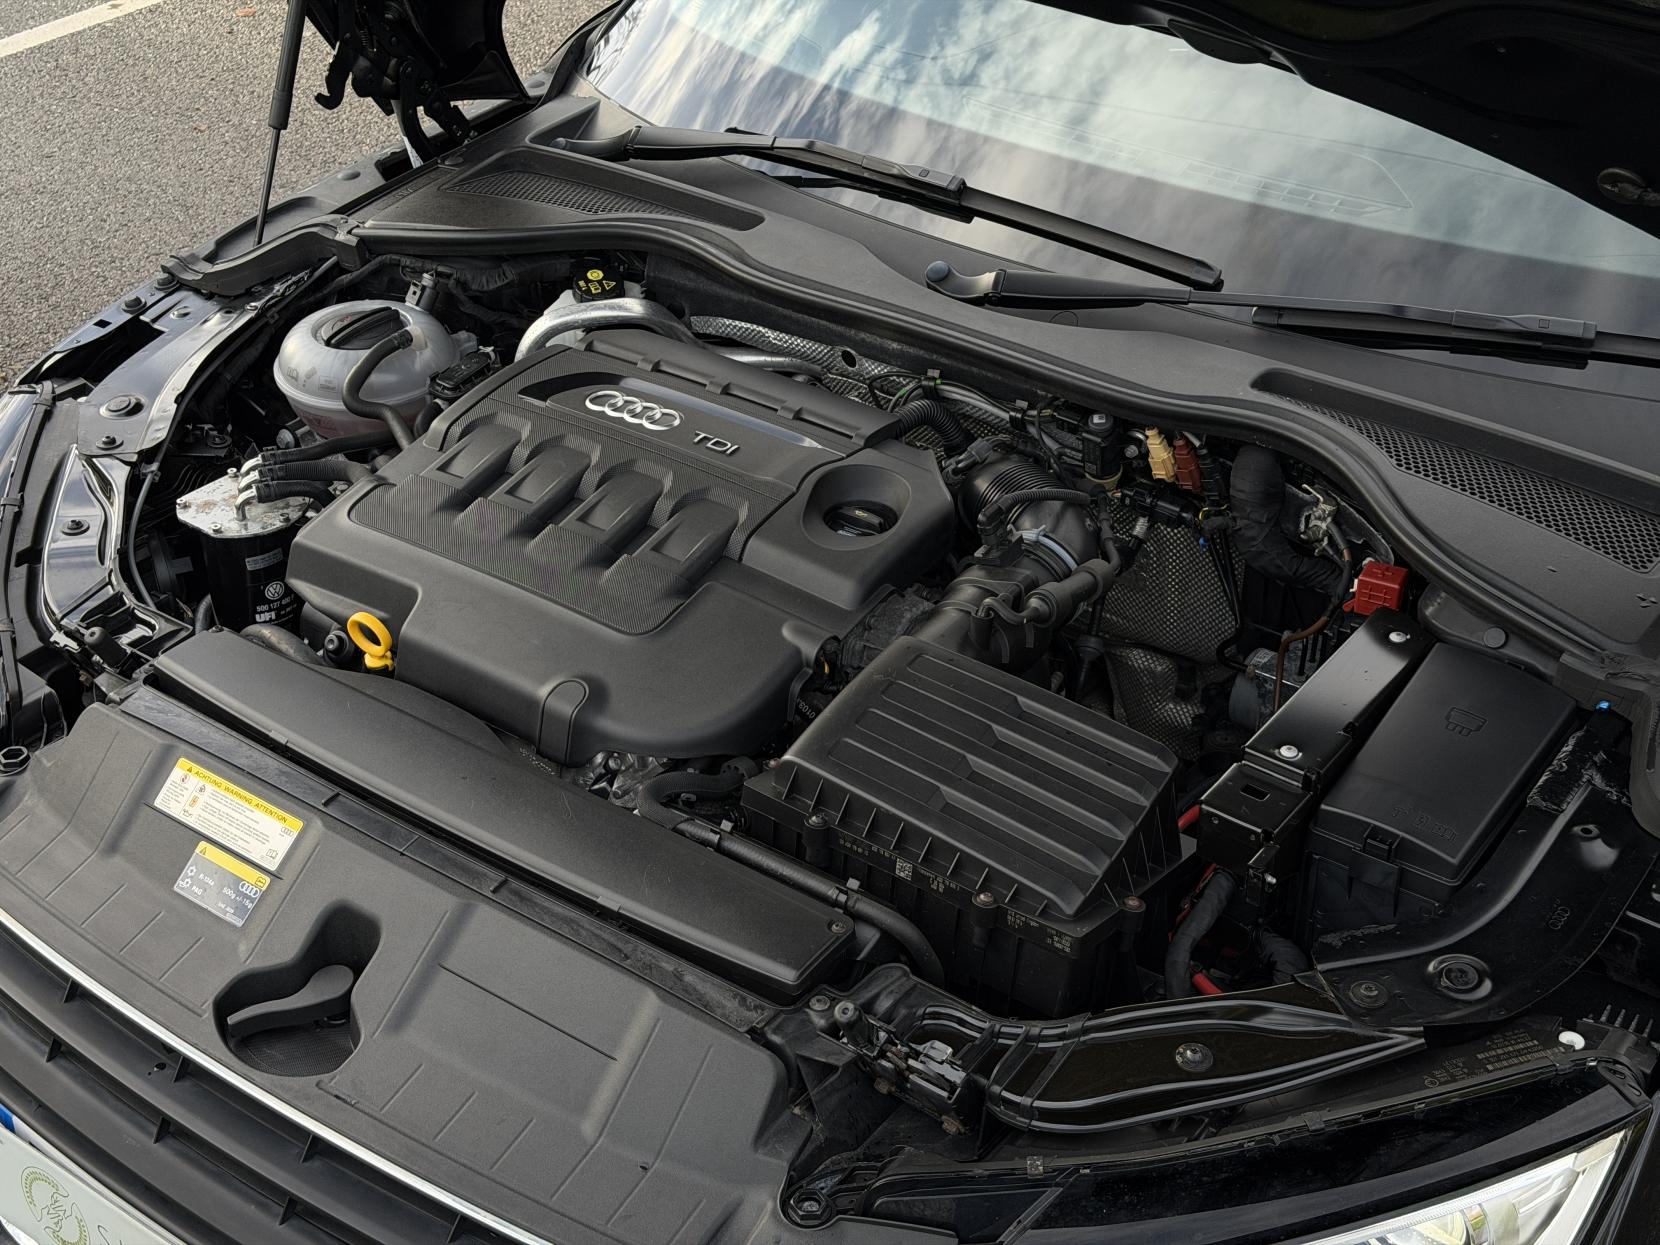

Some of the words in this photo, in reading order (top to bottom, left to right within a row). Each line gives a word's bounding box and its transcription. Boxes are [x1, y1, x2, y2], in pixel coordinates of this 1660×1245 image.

[693, 430, 740, 456] TDI
[255, 611, 276, 622] UFI
[195, 770, 223, 788] ACHTUNG
[224, 785, 253, 804] WARNING
[254, 802, 288, 823] ATTENTION
[191, 885, 203, 896] PAG
